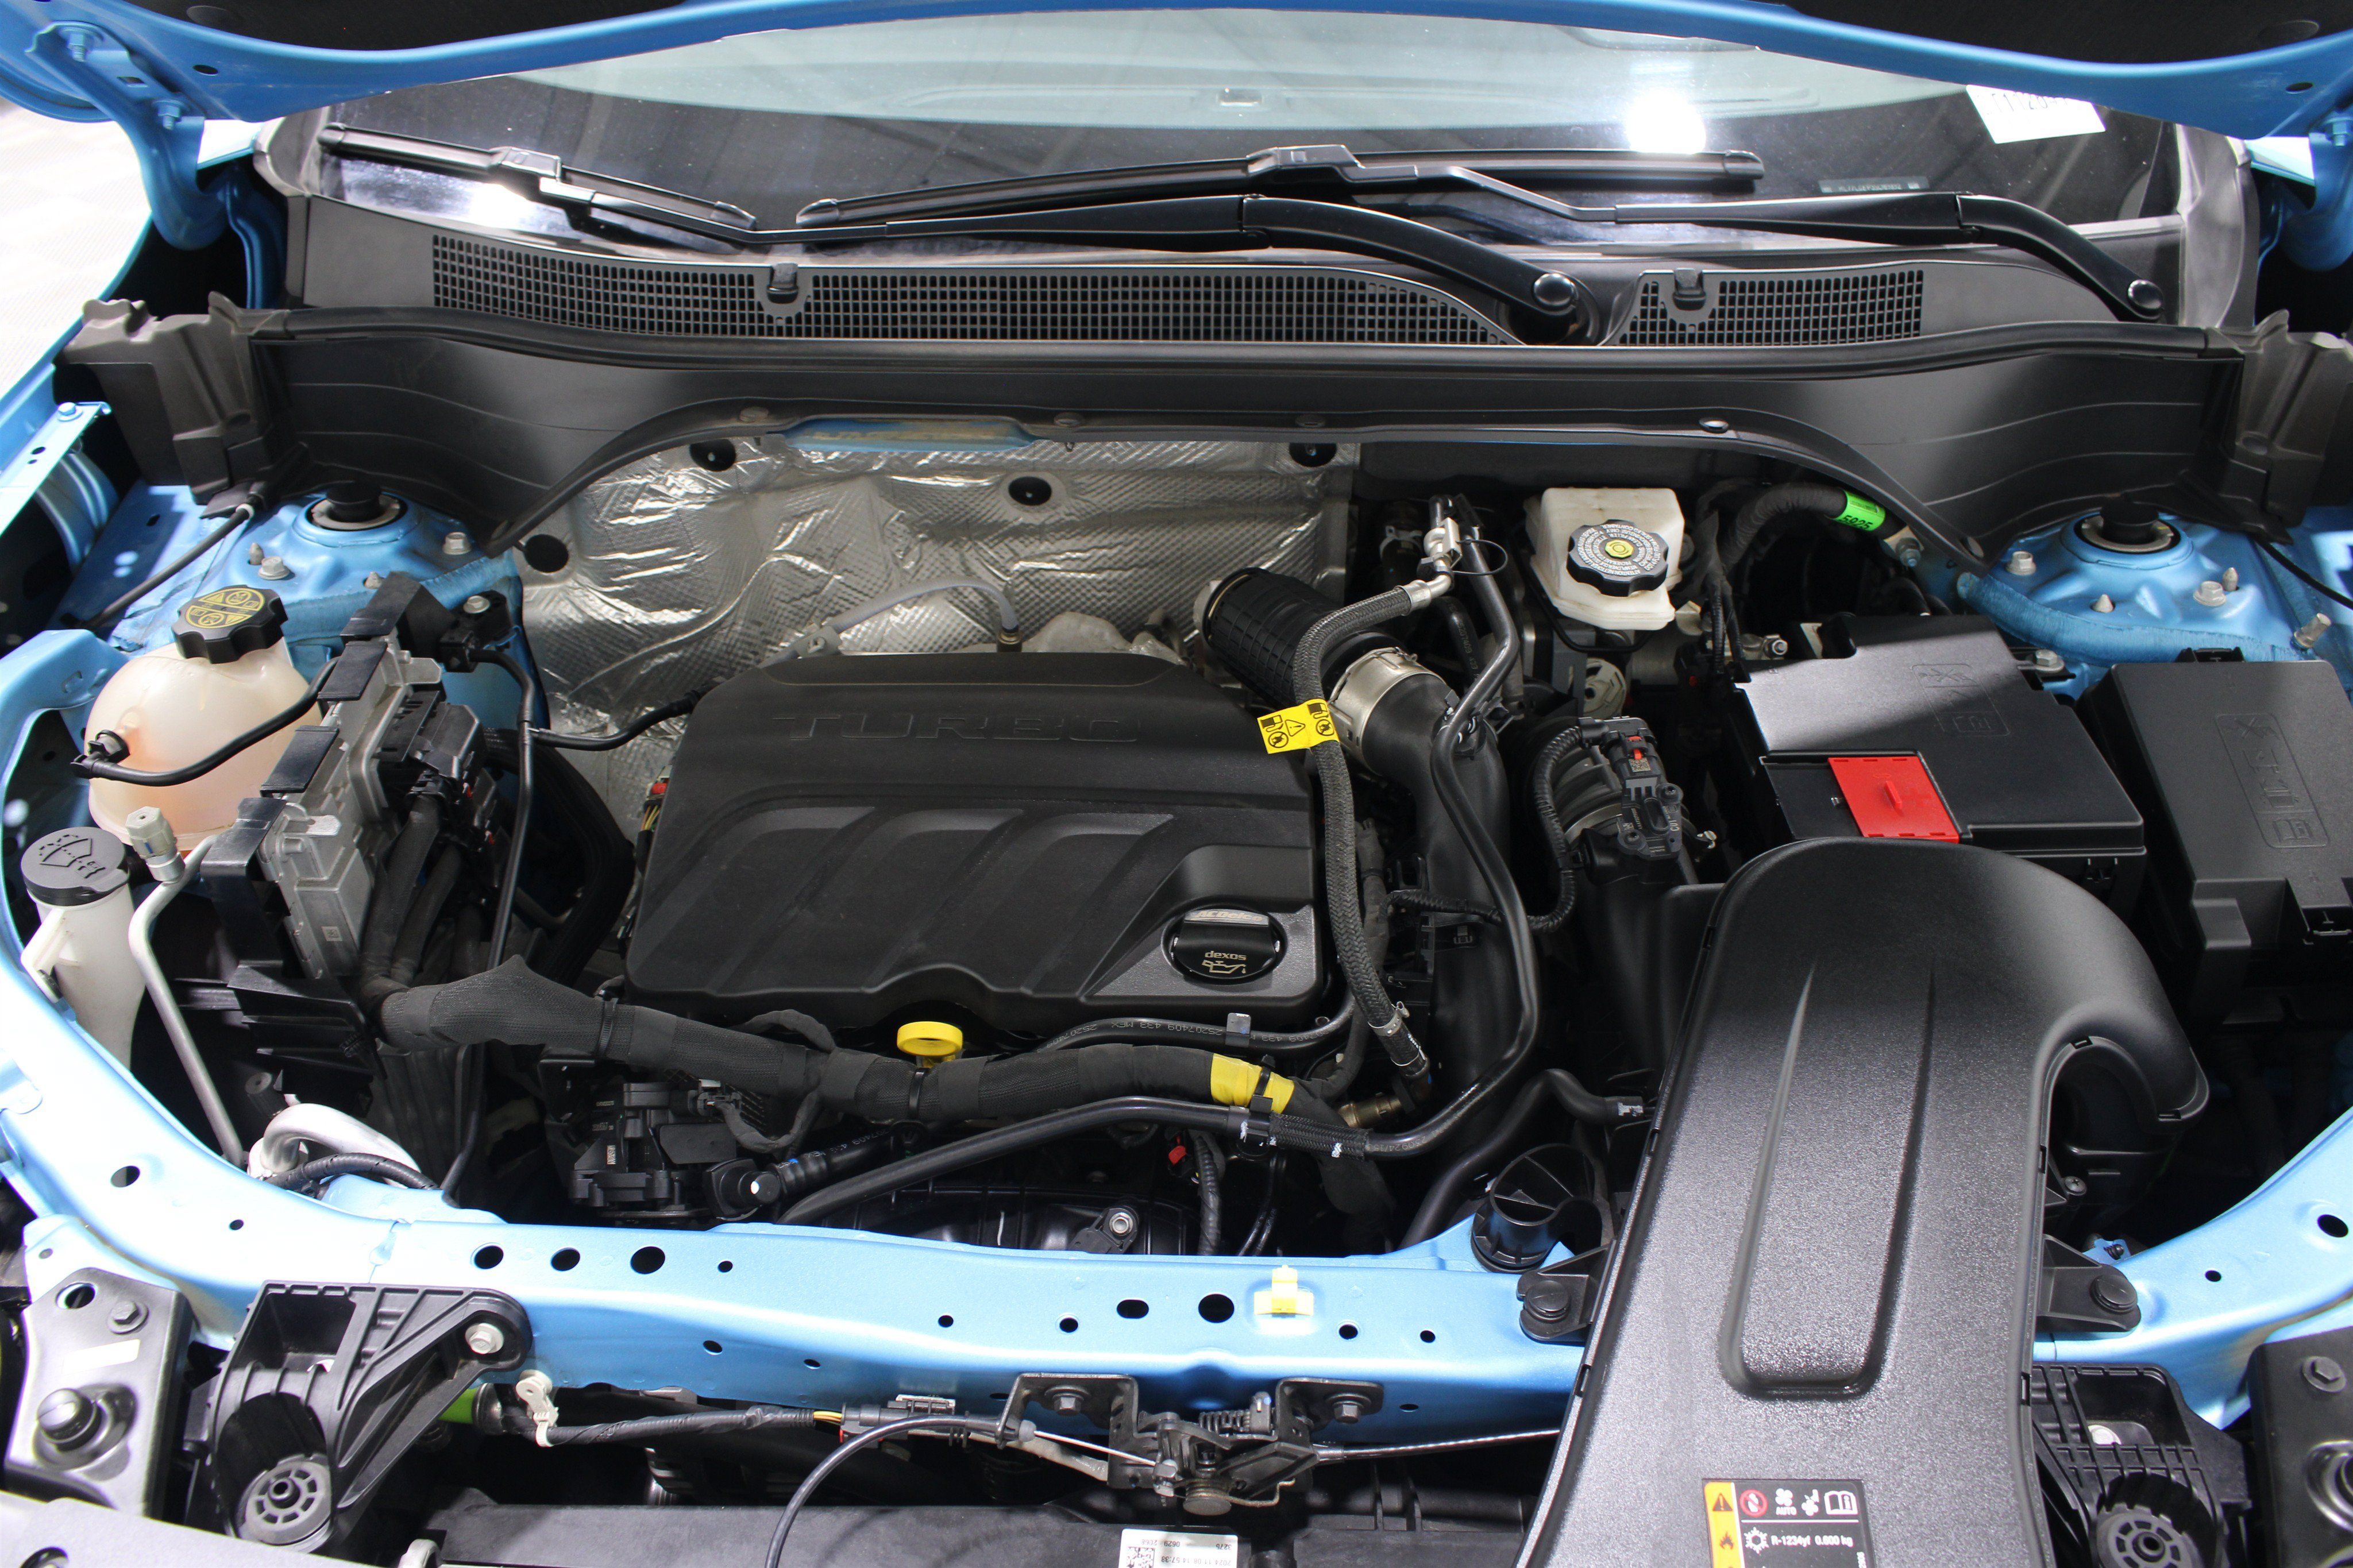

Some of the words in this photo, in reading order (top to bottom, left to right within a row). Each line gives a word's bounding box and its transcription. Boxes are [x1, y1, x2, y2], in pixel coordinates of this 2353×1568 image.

[773, 713, 1140, 743] TURBO
[1195, 911, 1263, 922] ACDelco
[1205, 951, 1247, 961] dexos
[1167, 1023, 1222, 1035] 25207409
[1776, 1507, 1797, 1516] AUTO
[1771, 1535, 1811, 1547] R-1234yf
[1842, 1535, 1854, 1547] kg
